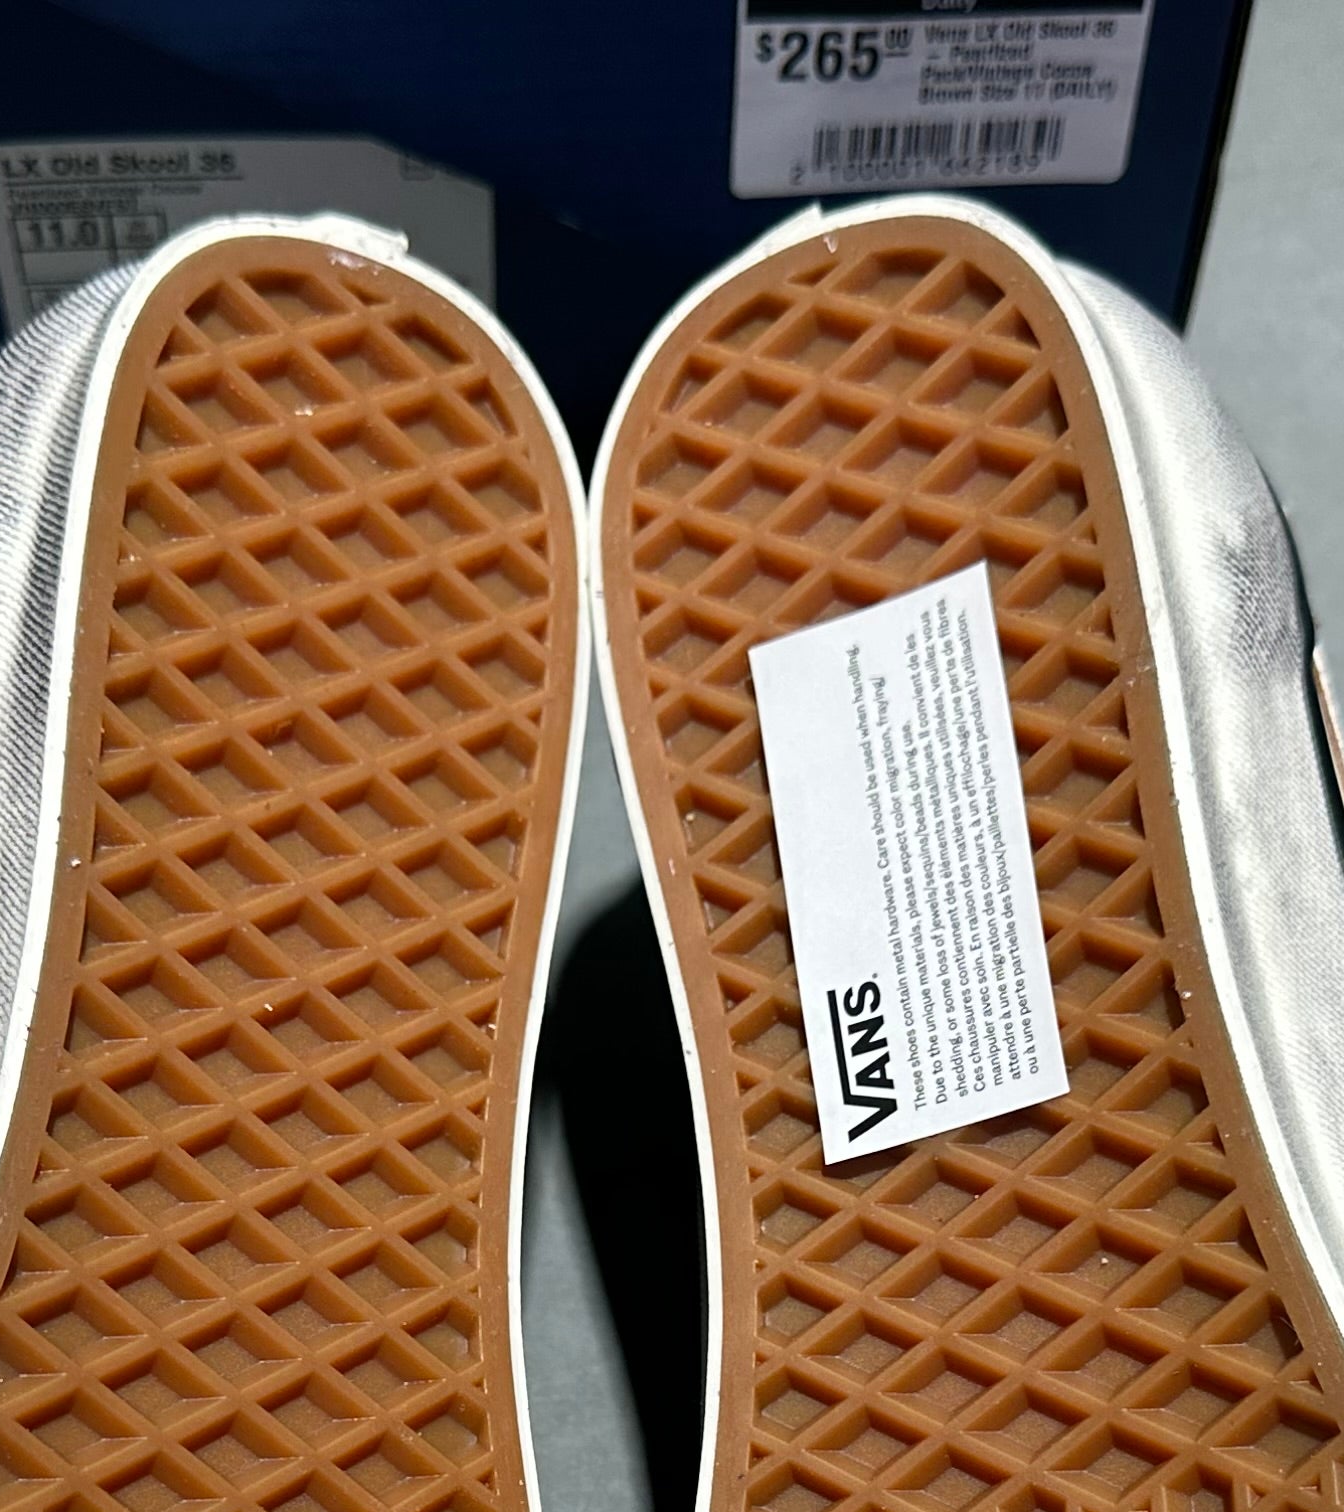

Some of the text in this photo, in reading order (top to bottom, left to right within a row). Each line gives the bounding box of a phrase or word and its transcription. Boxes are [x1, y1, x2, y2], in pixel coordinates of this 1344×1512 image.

[755, 30, 883, 82] $265
[1, 158, 42, 178] LX
[50, 155, 100, 177] Old
[109, 152, 190, 174] Skool
[26, 220, 99, 248] 11.0
[919, 610, 934, 644] vous
[935, 597, 951, 639] fibres
[902, 632, 918, 655] les
[923, 643, 942, 692] veuillez
[944, 657, 963, 695] perte
[854, 703, 870, 740] when
[868, 676, 890, 728] fraying/
[909, 671, 930, 729] convient
[966, 685, 989, 743] pendant
[900, 719, 914, 748] use.
[950, 695, 977, 798] effilochage/une
[857, 739, 876, 773] used
[902, 746, 921, 792] during
[941, 751, 960, 804] uniques
[865, 791, 885, 836] should
[888, 796, 906, 829] color
[949, 804, 969, 863] matières
[875, 837, 891, 870] Care
[894, 829, 913, 875] expect
[908, 792, 946, 933] jewels/sequins/beads
[972, 828, 992, 891] couleurs,
[902, 875, 922, 920] please
[942, 880, 958, 906] des
[957, 863, 973, 889] des
[881, 869, 901, 938] hardware.
[962, 889, 980, 932] raison
[980, 891, 996, 917] des
[999, 894, 1015, 920] des
[887, 936, 907, 976] metal
[907, 919, 929, 987] materials,
[934, 948, 950, 978] loss
[945, 906, 970, 987] contiennent
[971, 951, 988, 985] soin.
[985, 917, 1007, 982] migration
[1002, 920, 1026, 977] partielle
[894, 976, 915, 1027] contain
[919, 987, 937, 1033] unique
[939, 977, 956, 1014] some
[978, 985, 993, 1018] avec
[996, 983, 1011, 1010] une
[1012, 977, 1033, 1017] perte
[925, 1034, 942, 1059] the
[959, 987, 982, 1065] chaussures
[1020, 1017, 1035, 1044] une
[826, 980, 899, 1144] VANS
[904, 1028, 922, 1069] shoes
[946, 1031, 970, 1098] shedding,
[981, 1020, 1004, 1087] manipuler
[1000, 1021, 1022, 1081] attendre
[911, 1069, 928, 1112] These
[933, 1078, 949, 1105] Due
[971, 1065, 987, 1093] Ces
